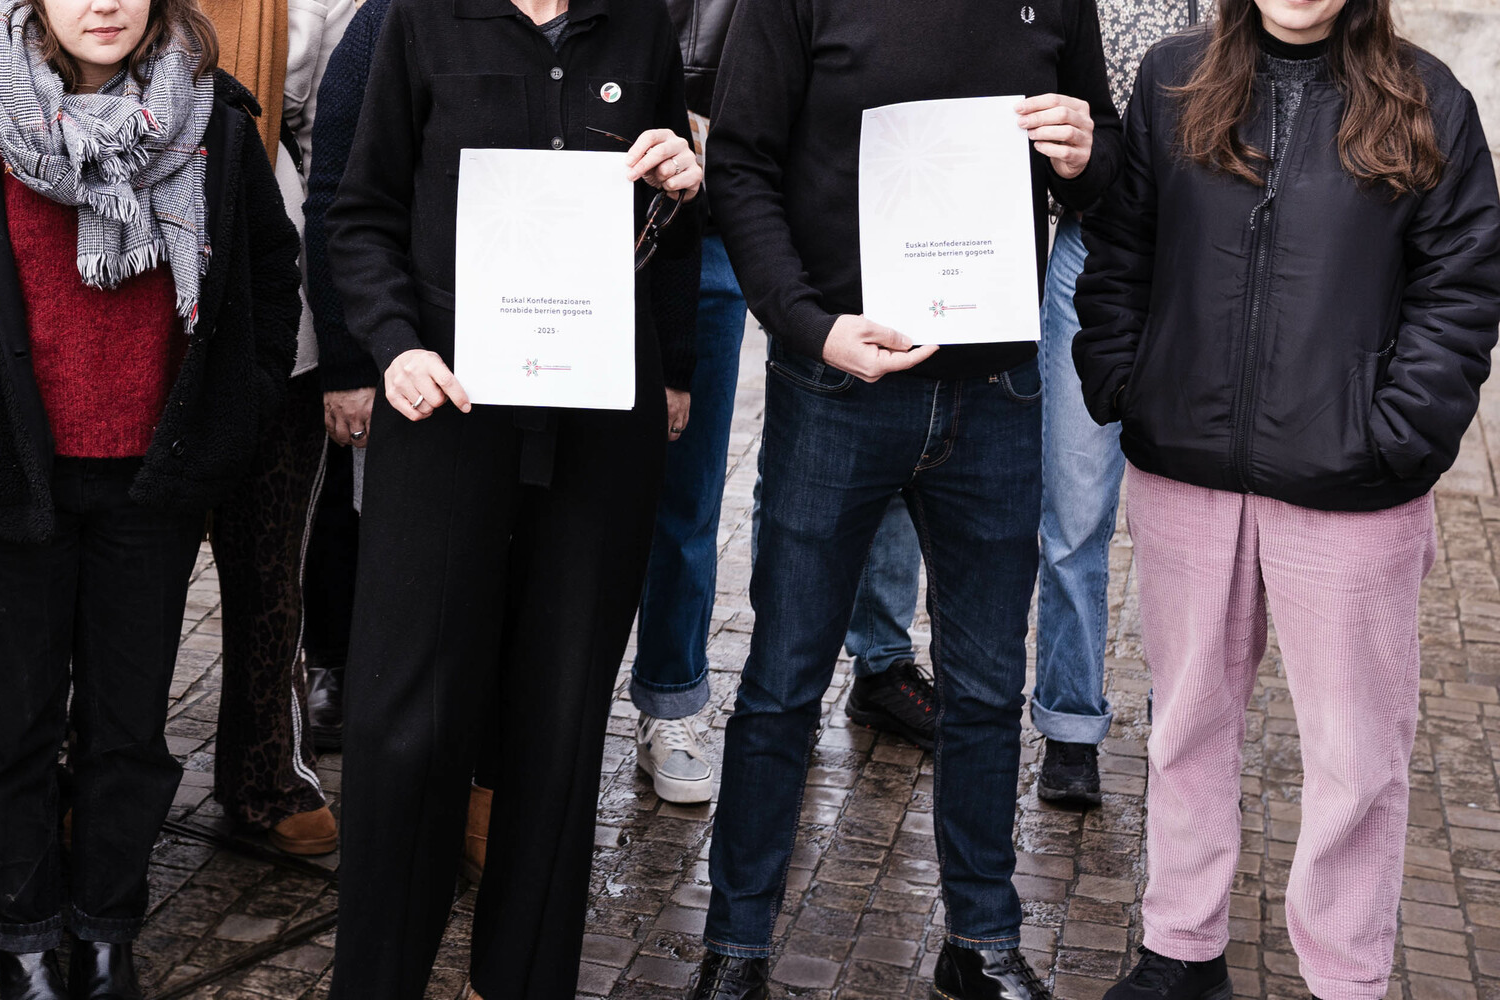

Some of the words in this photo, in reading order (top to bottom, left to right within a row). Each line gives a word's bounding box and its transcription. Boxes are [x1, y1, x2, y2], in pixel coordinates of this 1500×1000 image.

[905, 241, 928, 249] Euskal
[930, 239, 992, 248] Konfederazioaren
[904, 250, 936, 258] norabide
[965, 249, 994, 257] gogoeta
[501, 296, 525, 304] Euskal
[527, 297, 591, 305] Konfederazioaren
